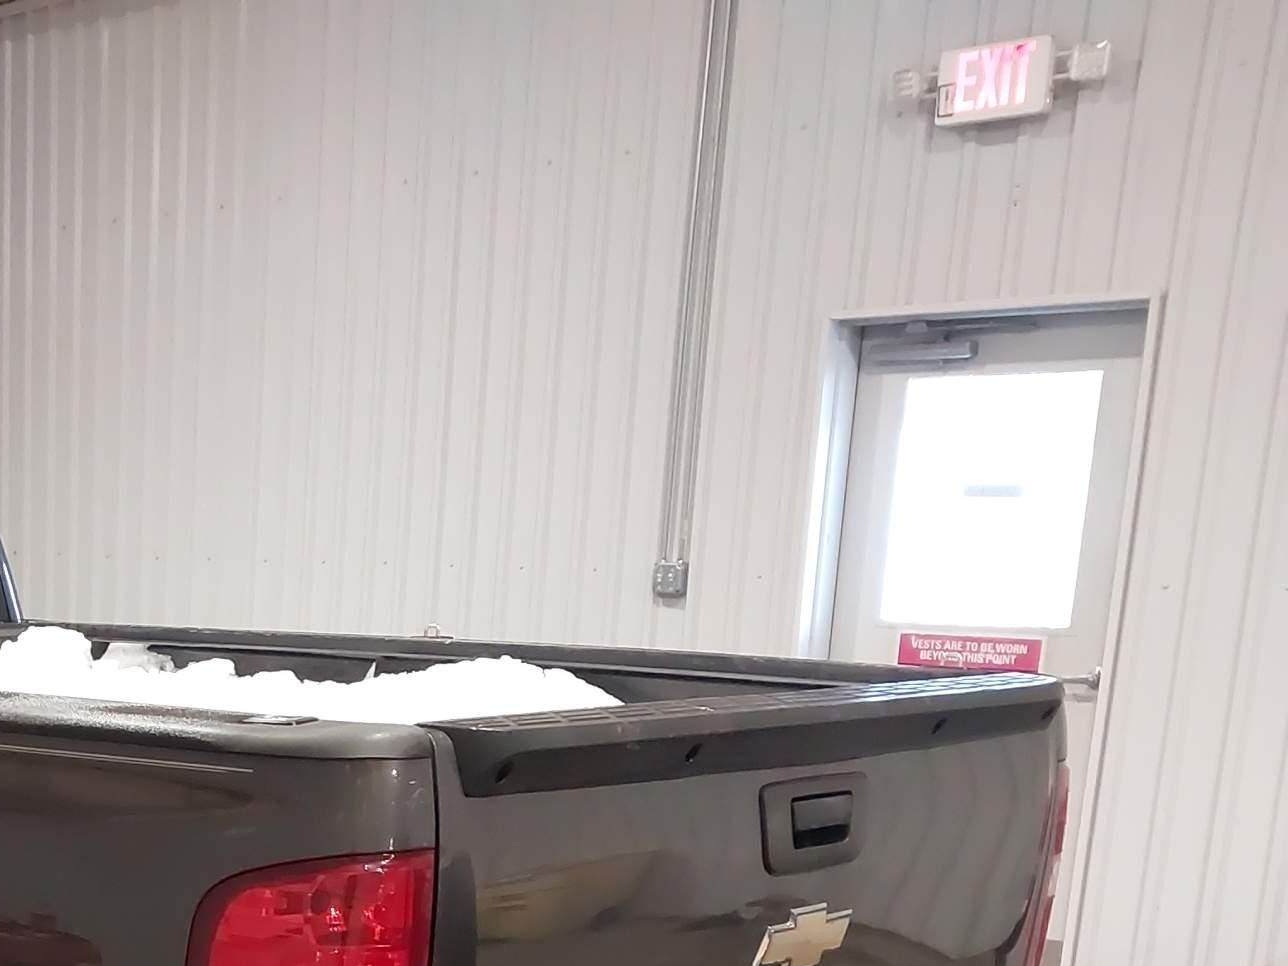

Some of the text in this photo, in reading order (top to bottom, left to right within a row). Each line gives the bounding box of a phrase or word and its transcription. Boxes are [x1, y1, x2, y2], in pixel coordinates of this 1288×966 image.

[953, 39, 1037, 114] EXIT
[911, 637, 1029, 655] VESTS ARE TO BE WORN
[962, 652, 984, 664] THIS
[985, 653, 1017, 665] POINT
